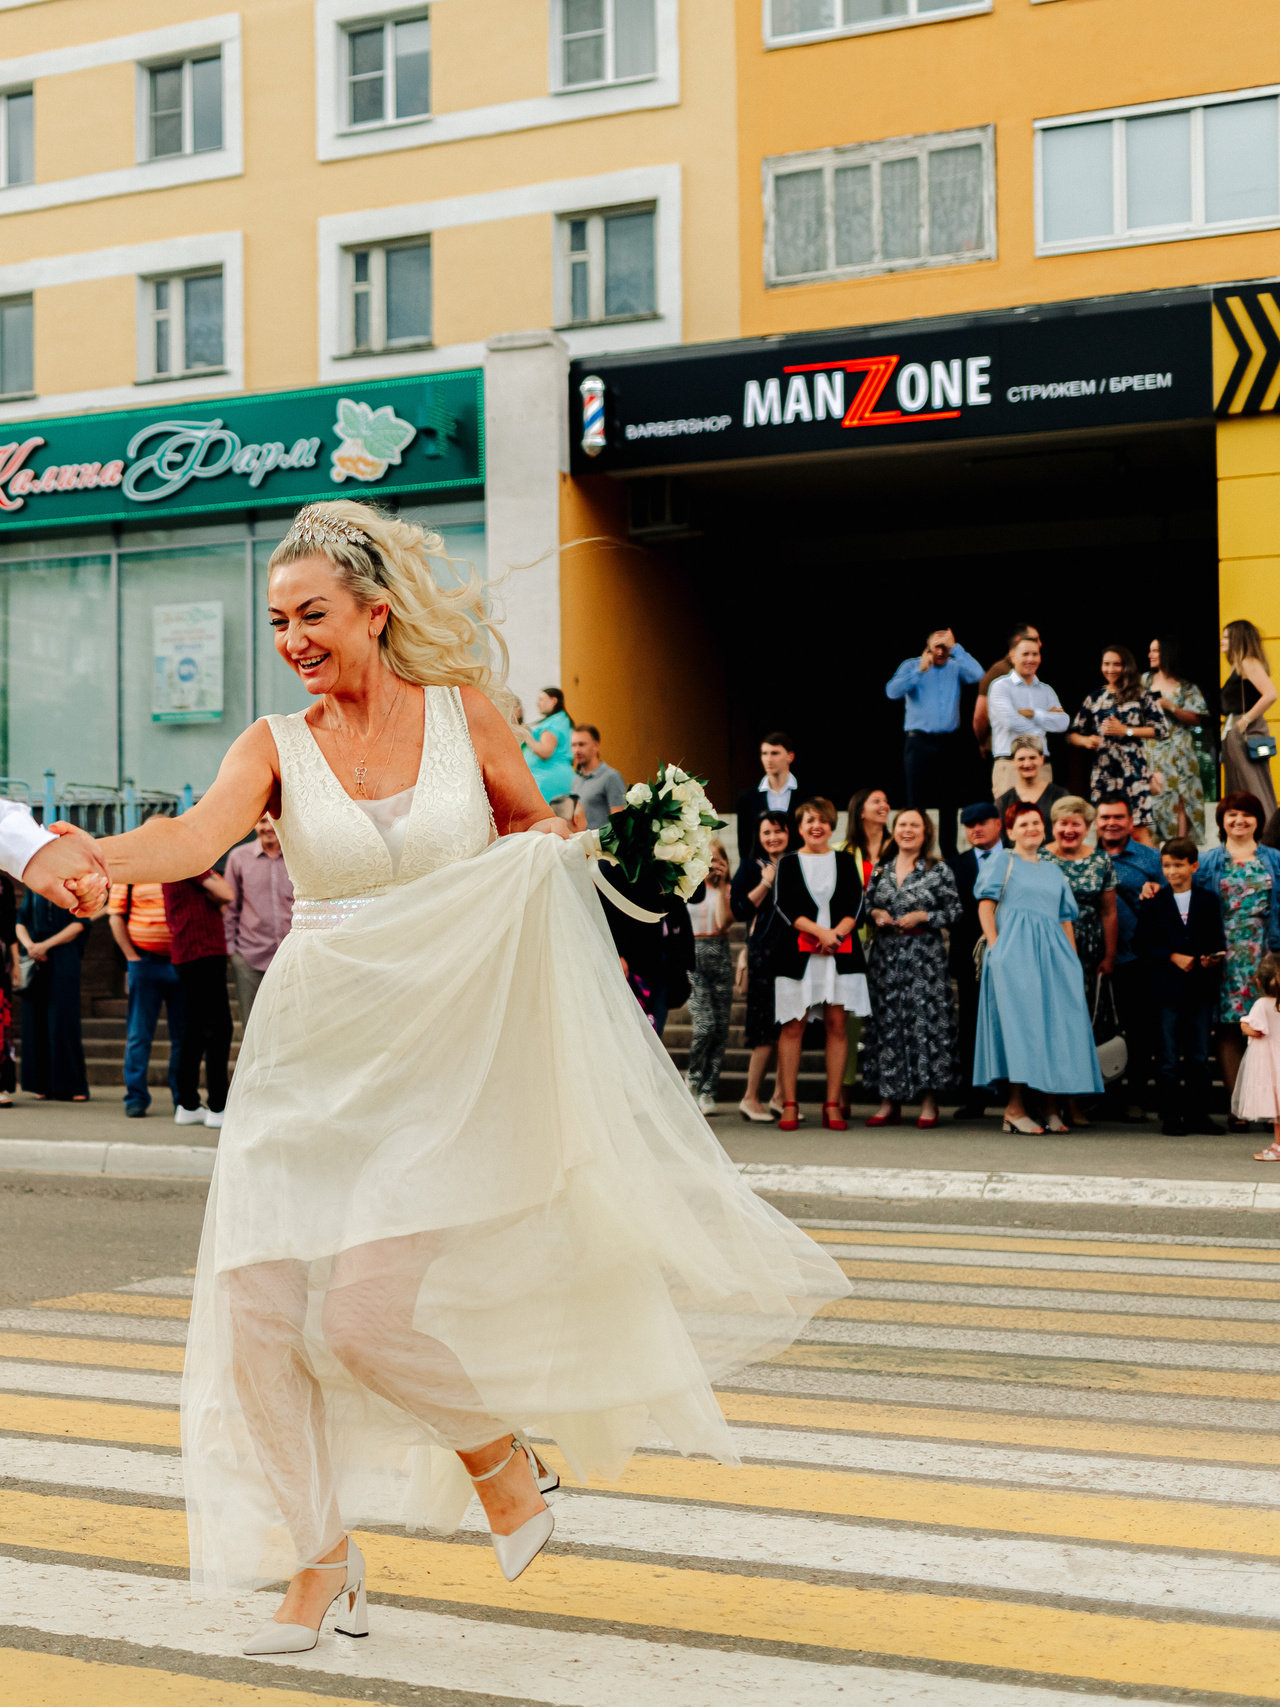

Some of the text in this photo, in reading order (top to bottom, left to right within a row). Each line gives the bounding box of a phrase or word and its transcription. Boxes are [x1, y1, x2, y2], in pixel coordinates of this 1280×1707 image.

[743, 354, 992, 428] MANZONE
[1006, 379, 1096, 403] СТРИЖЕМ
[1108, 372, 1172, 394] БРЕЕМ
[624, 414, 732, 440] BARBERSHOP
[122, 418, 320, 502] Фарм
